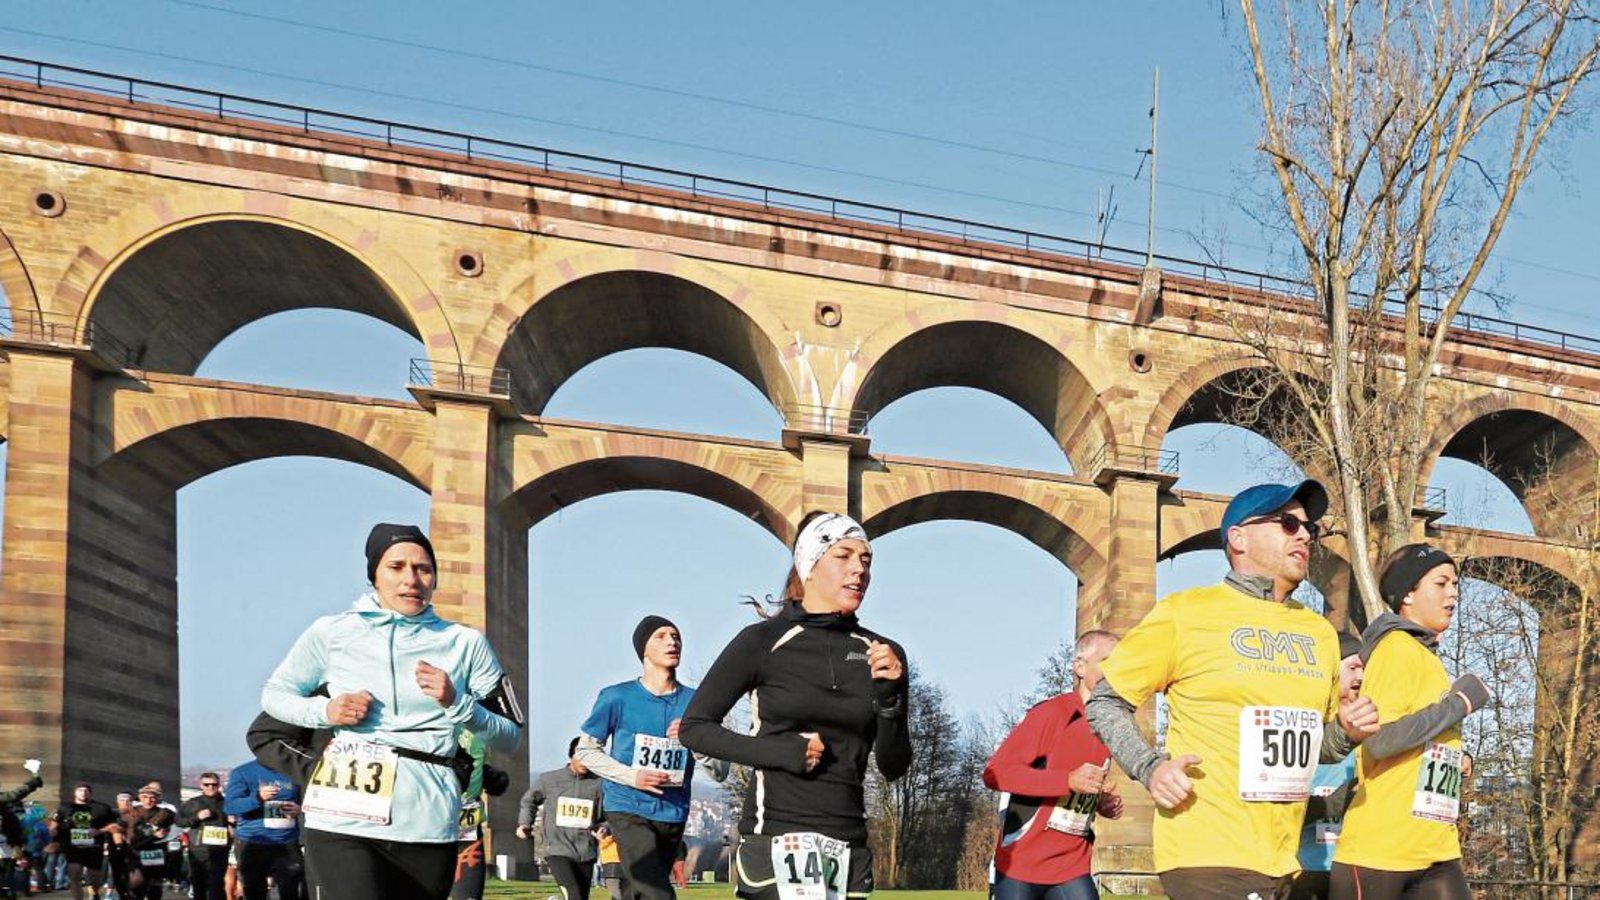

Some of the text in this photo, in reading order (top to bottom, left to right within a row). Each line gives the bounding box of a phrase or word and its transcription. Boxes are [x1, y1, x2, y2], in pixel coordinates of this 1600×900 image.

[1231, 627, 1317, 666] CMT
[1273, 709, 1318, 729] SWBB
[639, 746, 683, 770] 3438
[1262, 729, 1311, 768] 500
[562, 804, 589, 818] 1979
